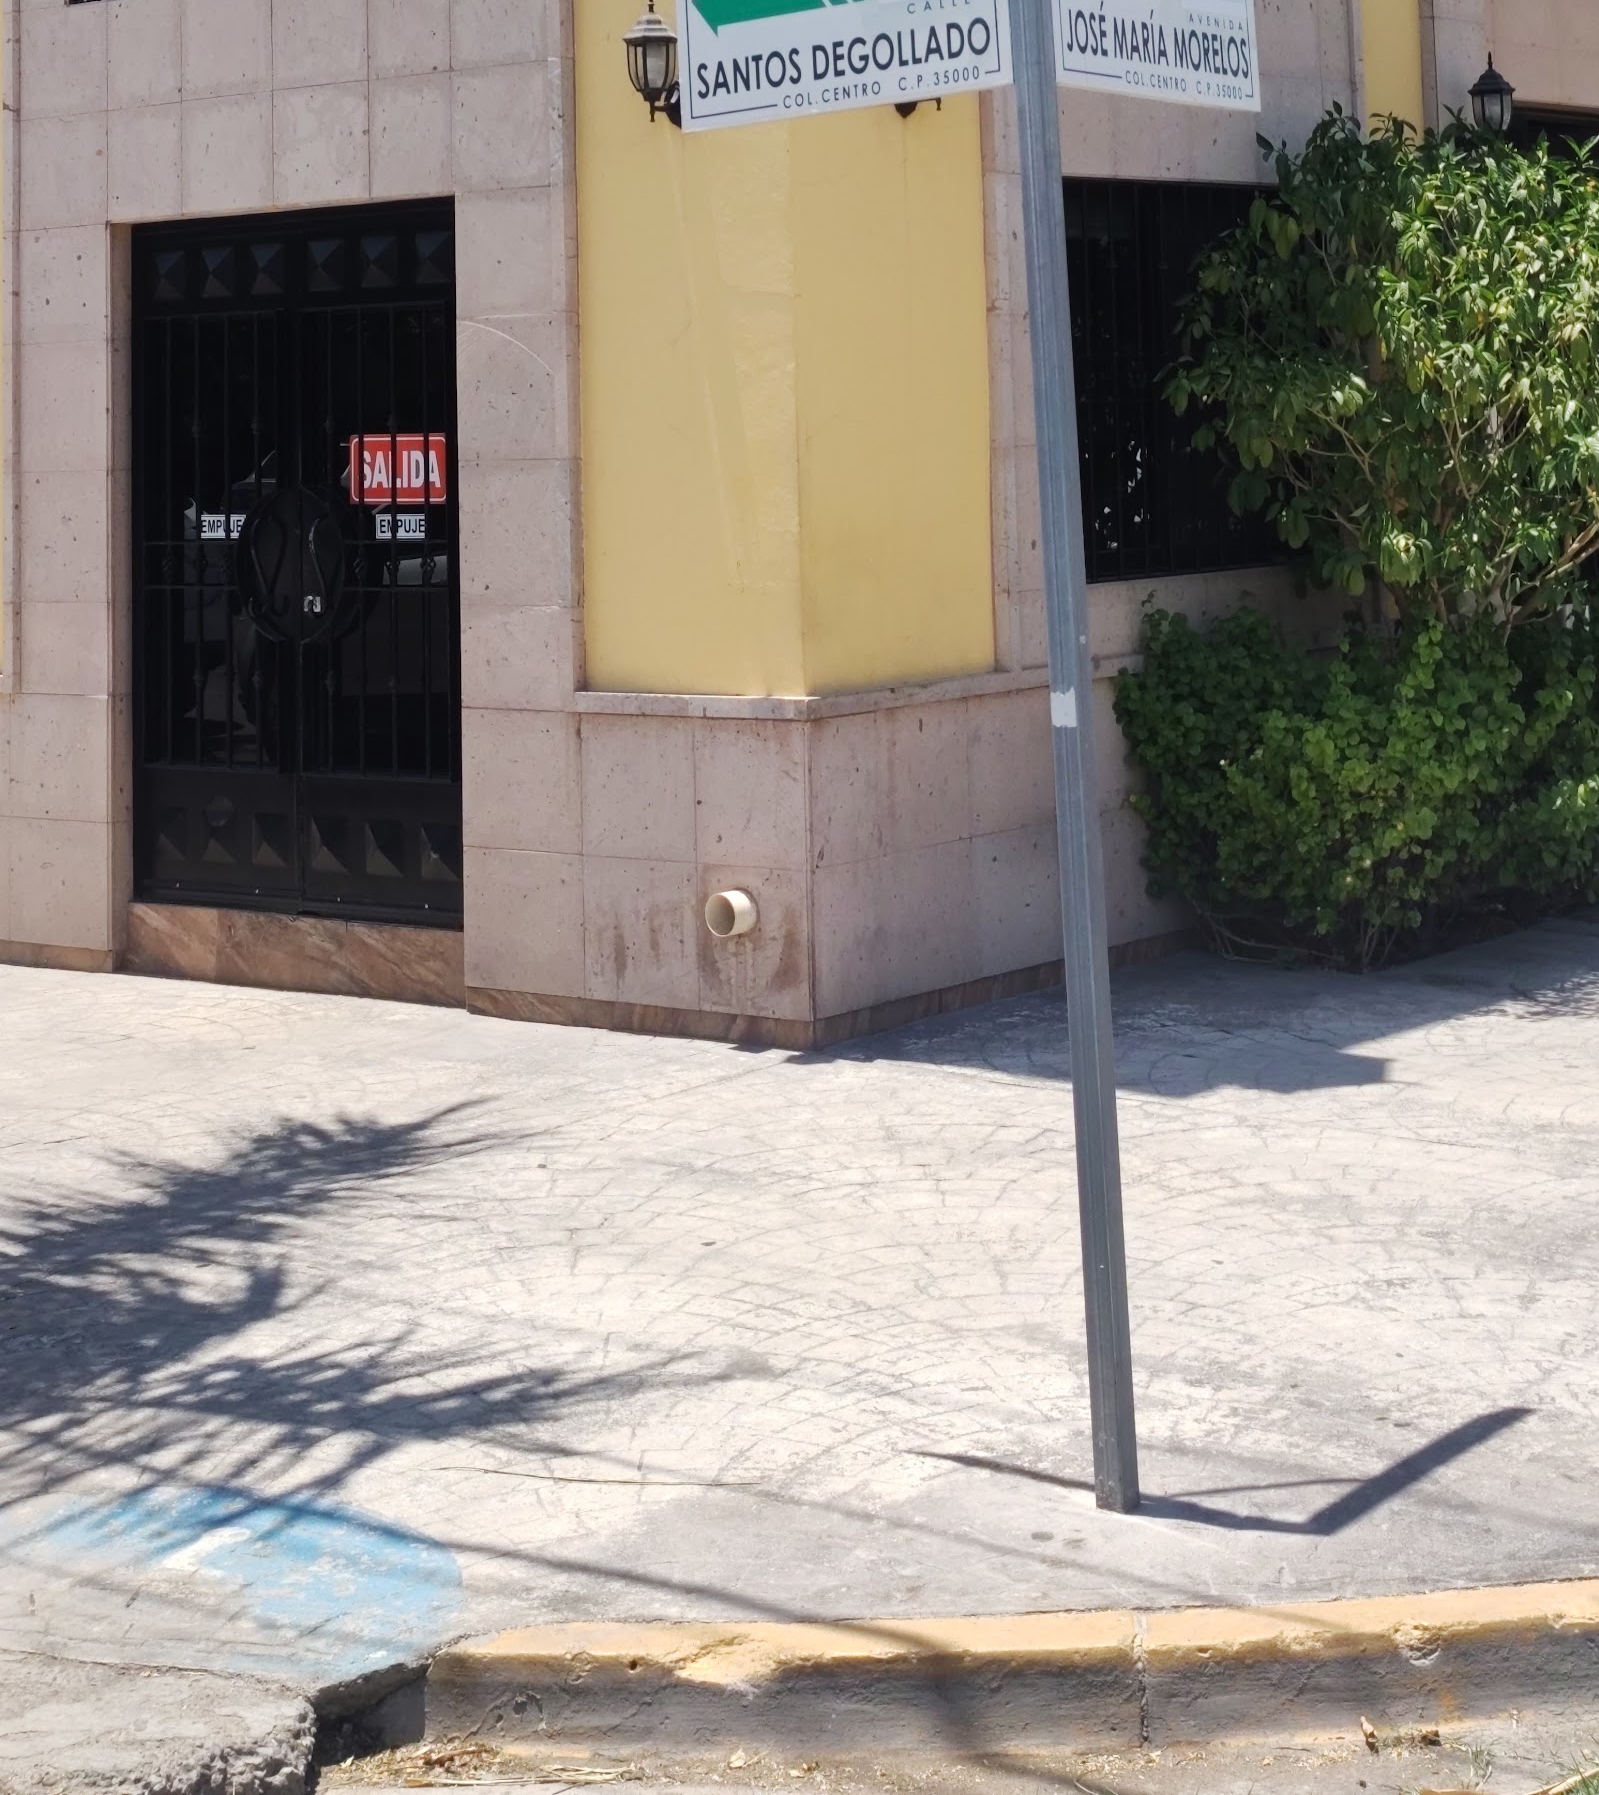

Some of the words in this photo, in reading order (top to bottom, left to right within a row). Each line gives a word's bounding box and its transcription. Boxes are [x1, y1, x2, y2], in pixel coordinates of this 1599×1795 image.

[1067, 0, 1109, 57] JOSÉ
[1113, 9, 1170, 66] MARÍA
[1174, 27, 1249, 79] MORELOS
[1188, 13, 1244, 32] AVENIDA
[696, 48, 802, 99] SANTOS
[812, 17, 991, 81] DEGOLLADO
[361, 450, 442, 489] SALIDA
[201, 519, 243, 534] EMPUJE
